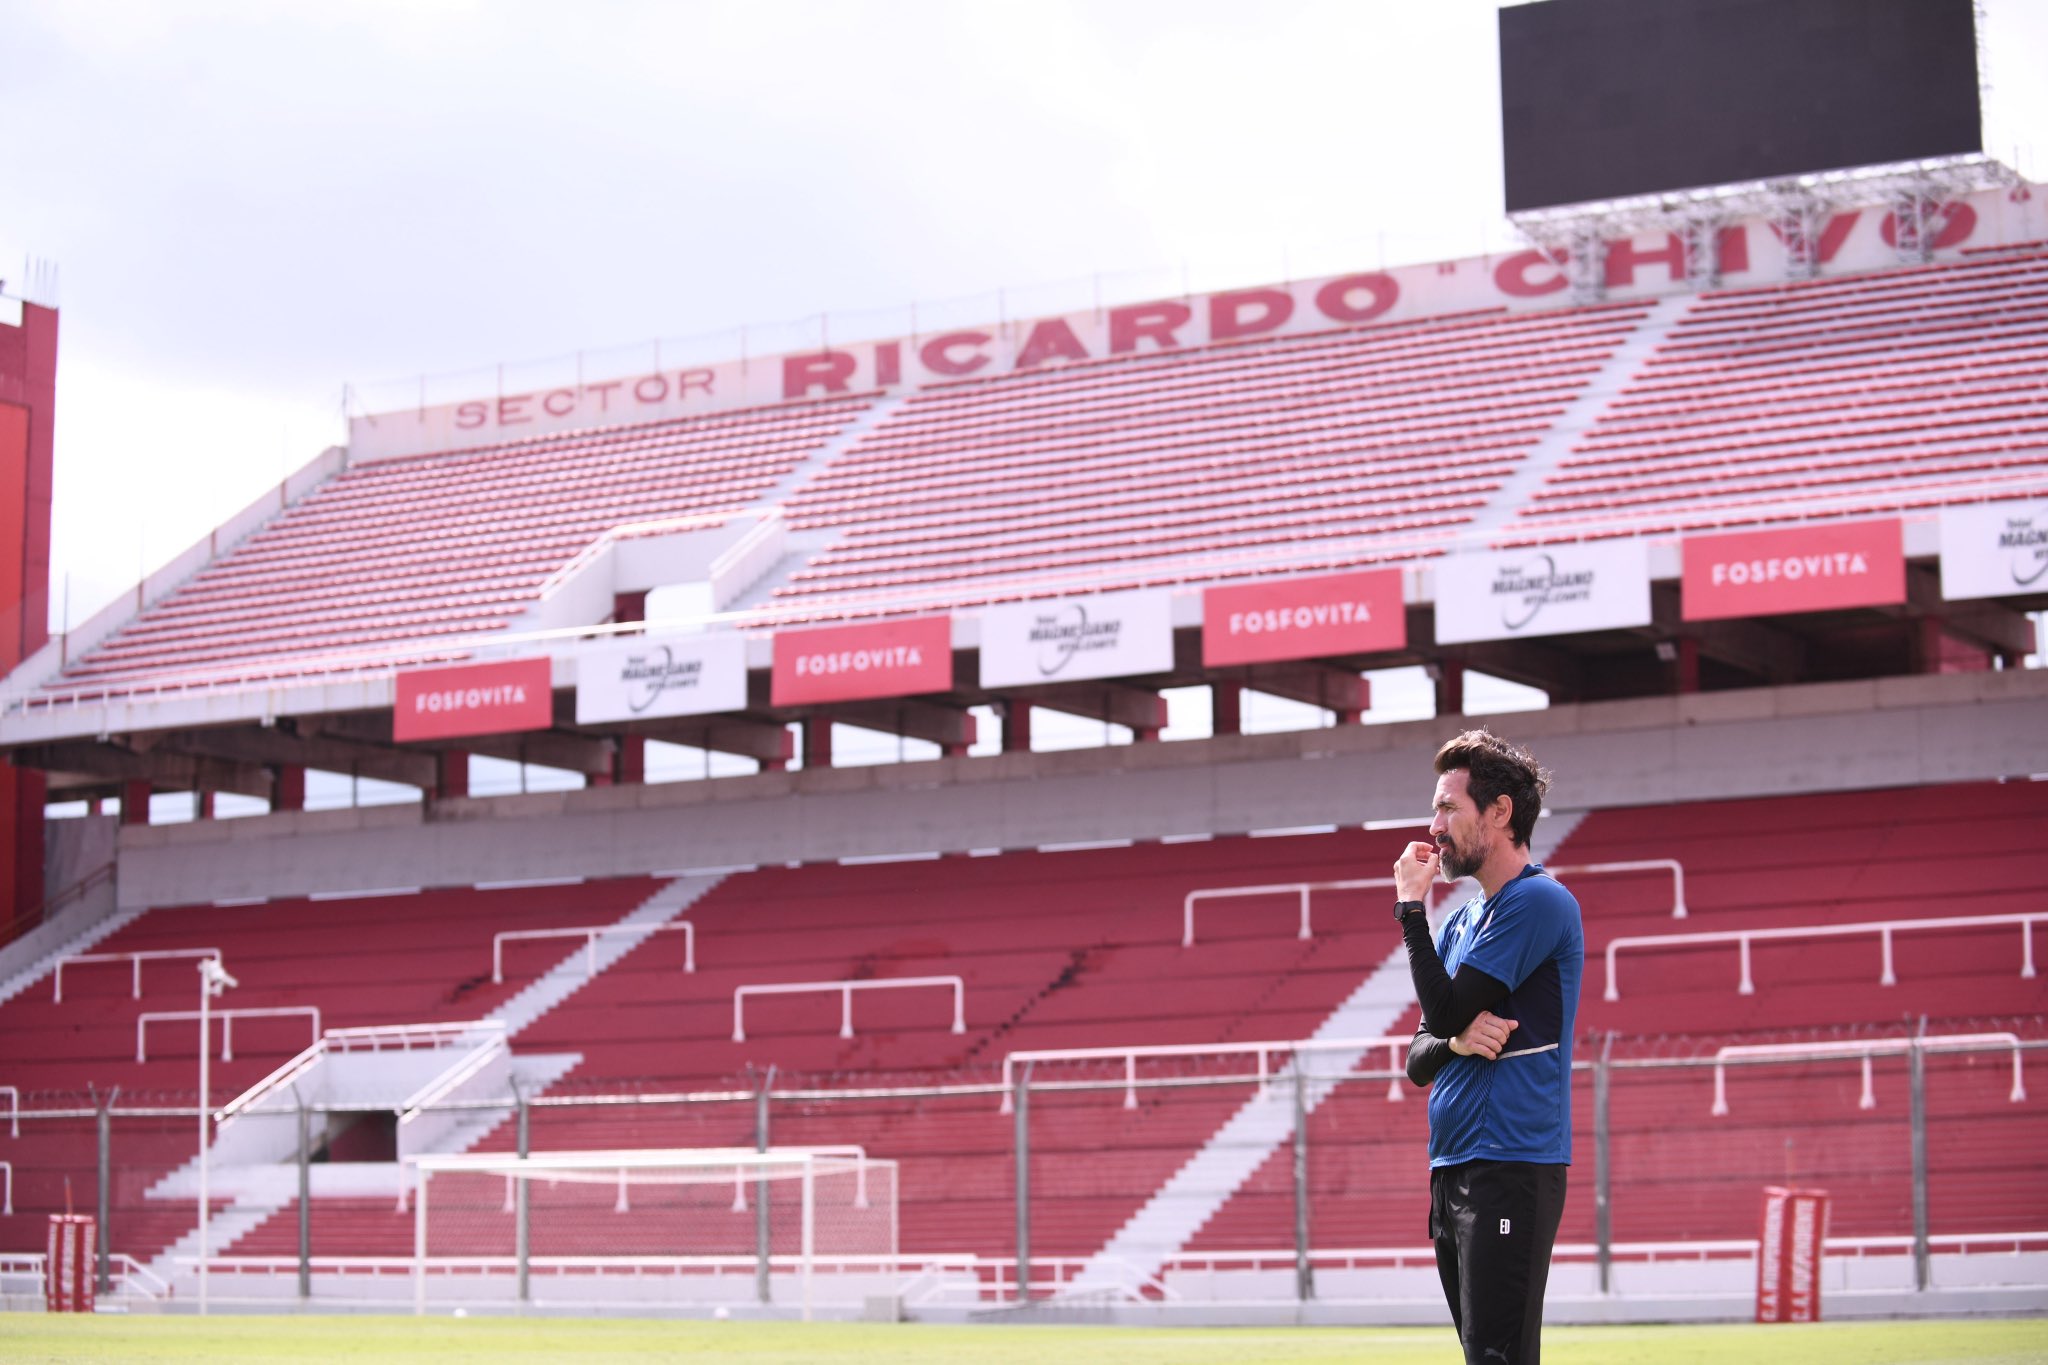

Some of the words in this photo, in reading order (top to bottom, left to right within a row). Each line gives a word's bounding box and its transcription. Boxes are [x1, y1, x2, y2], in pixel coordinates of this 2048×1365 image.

[456, 367, 716, 430] SECTOR
[782, 272, 1400, 398] RICARDO
[1712, 552, 1868, 587] FOSFOVITA
[1230, 602, 1371, 635] FOSFOVITA
[796, 647, 921, 677] FOSFOVITA
[416, 685, 526, 714] FOSFOVITA
